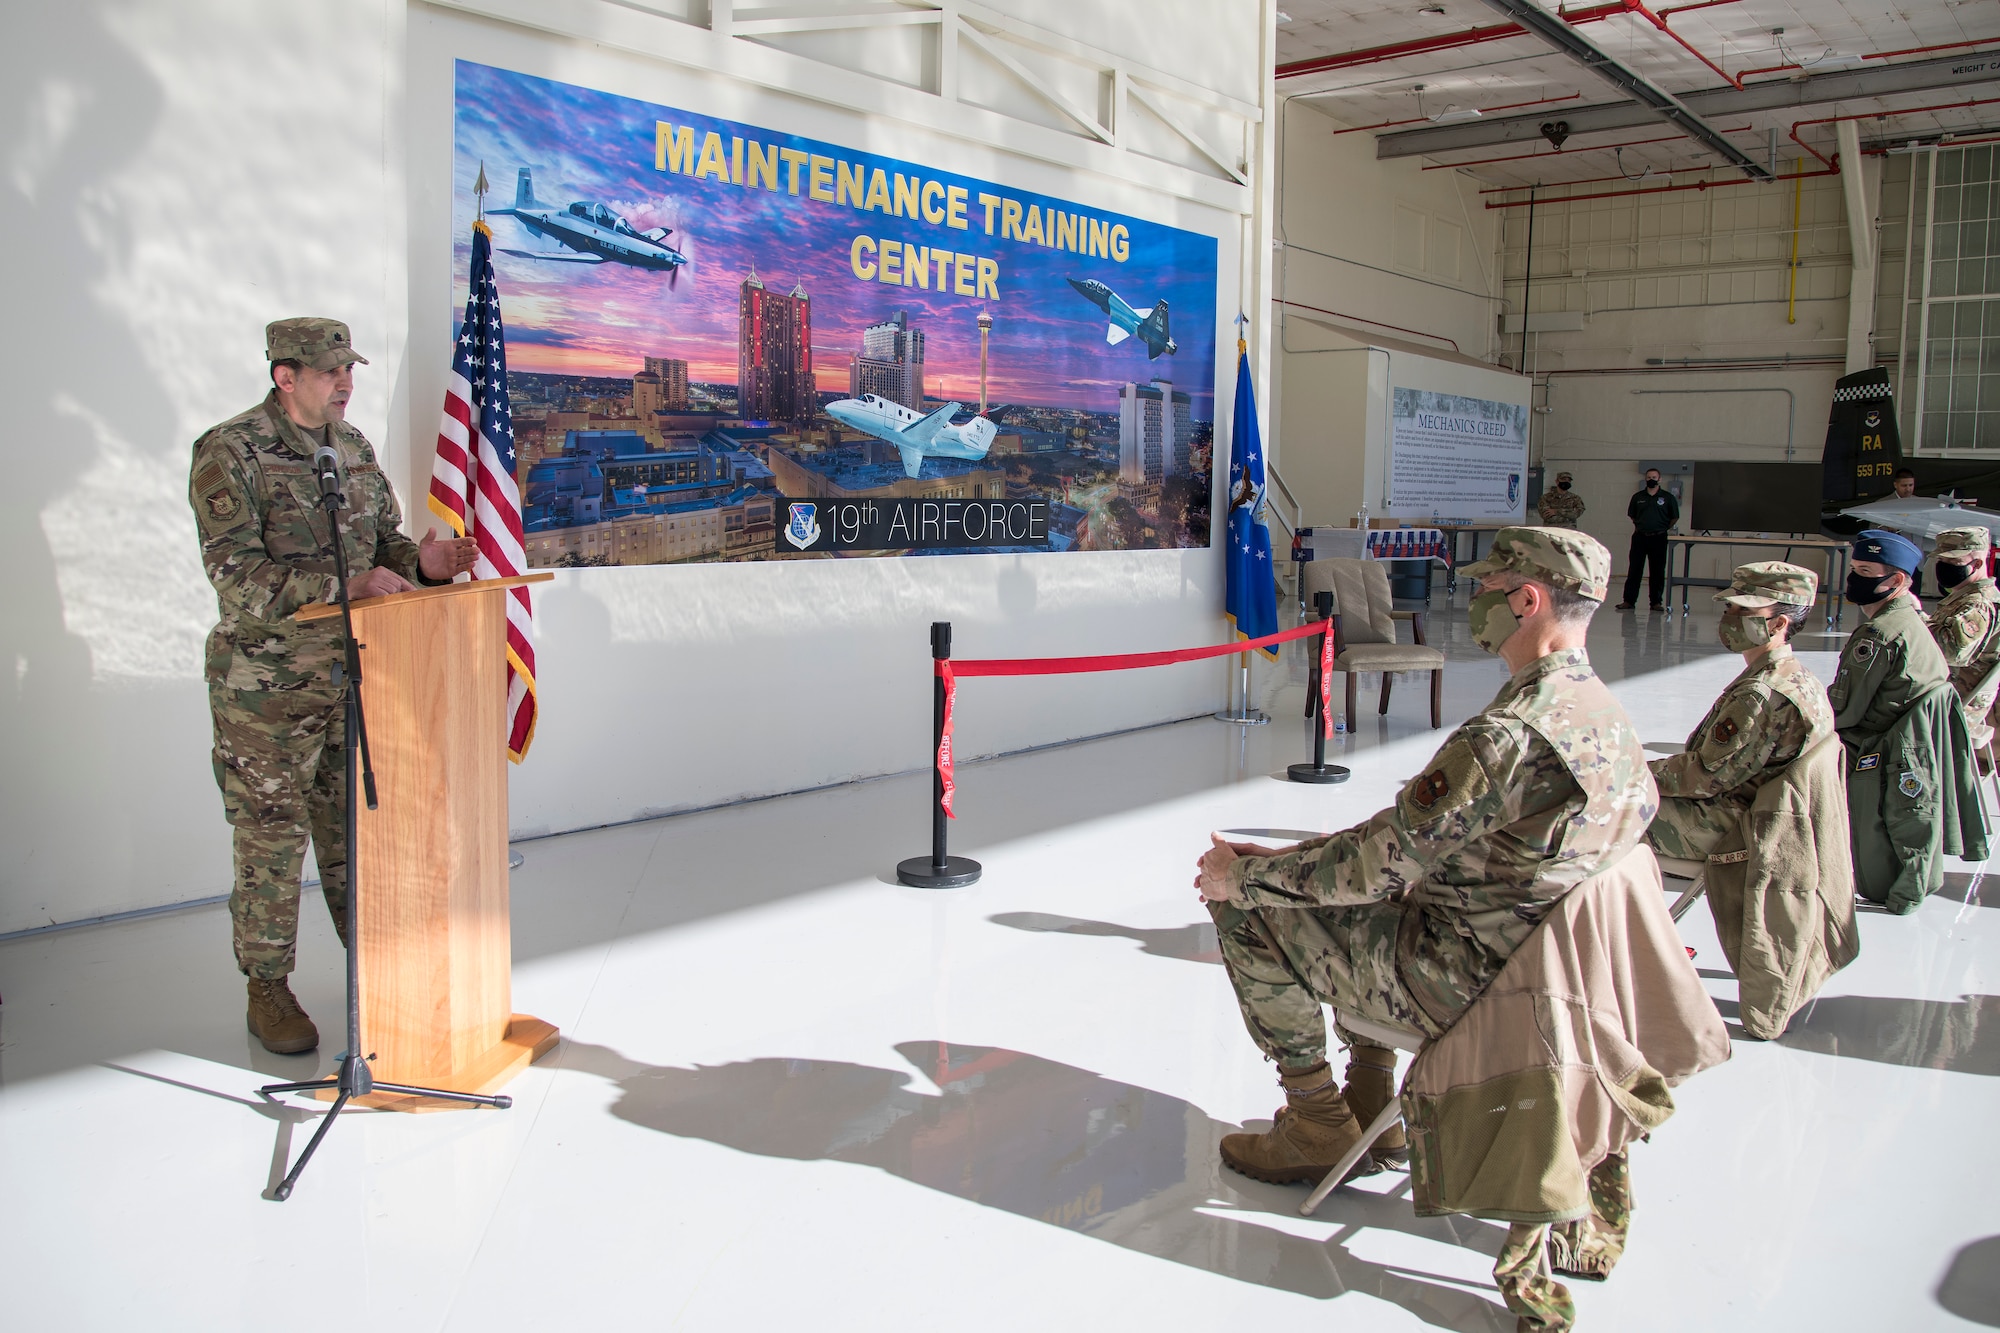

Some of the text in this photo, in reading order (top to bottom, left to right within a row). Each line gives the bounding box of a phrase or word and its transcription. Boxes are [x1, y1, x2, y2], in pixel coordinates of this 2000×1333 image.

[1952, 64, 1985, 74] WEIGHT
[655, 120, 1131, 263] MAINTENANCE TRAINING
[850, 235, 1000, 301] CENTER
[1418, 414, 1475, 434] MECHANICS
[1477, 421, 1506, 437] CREED
[1862, 434, 1882, 450] RA
[1856, 462, 1893, 477] 559 FTS
[827, 500, 1045, 543] 19th AIRFORCE
[941, 735, 950, 767] BEFORE
